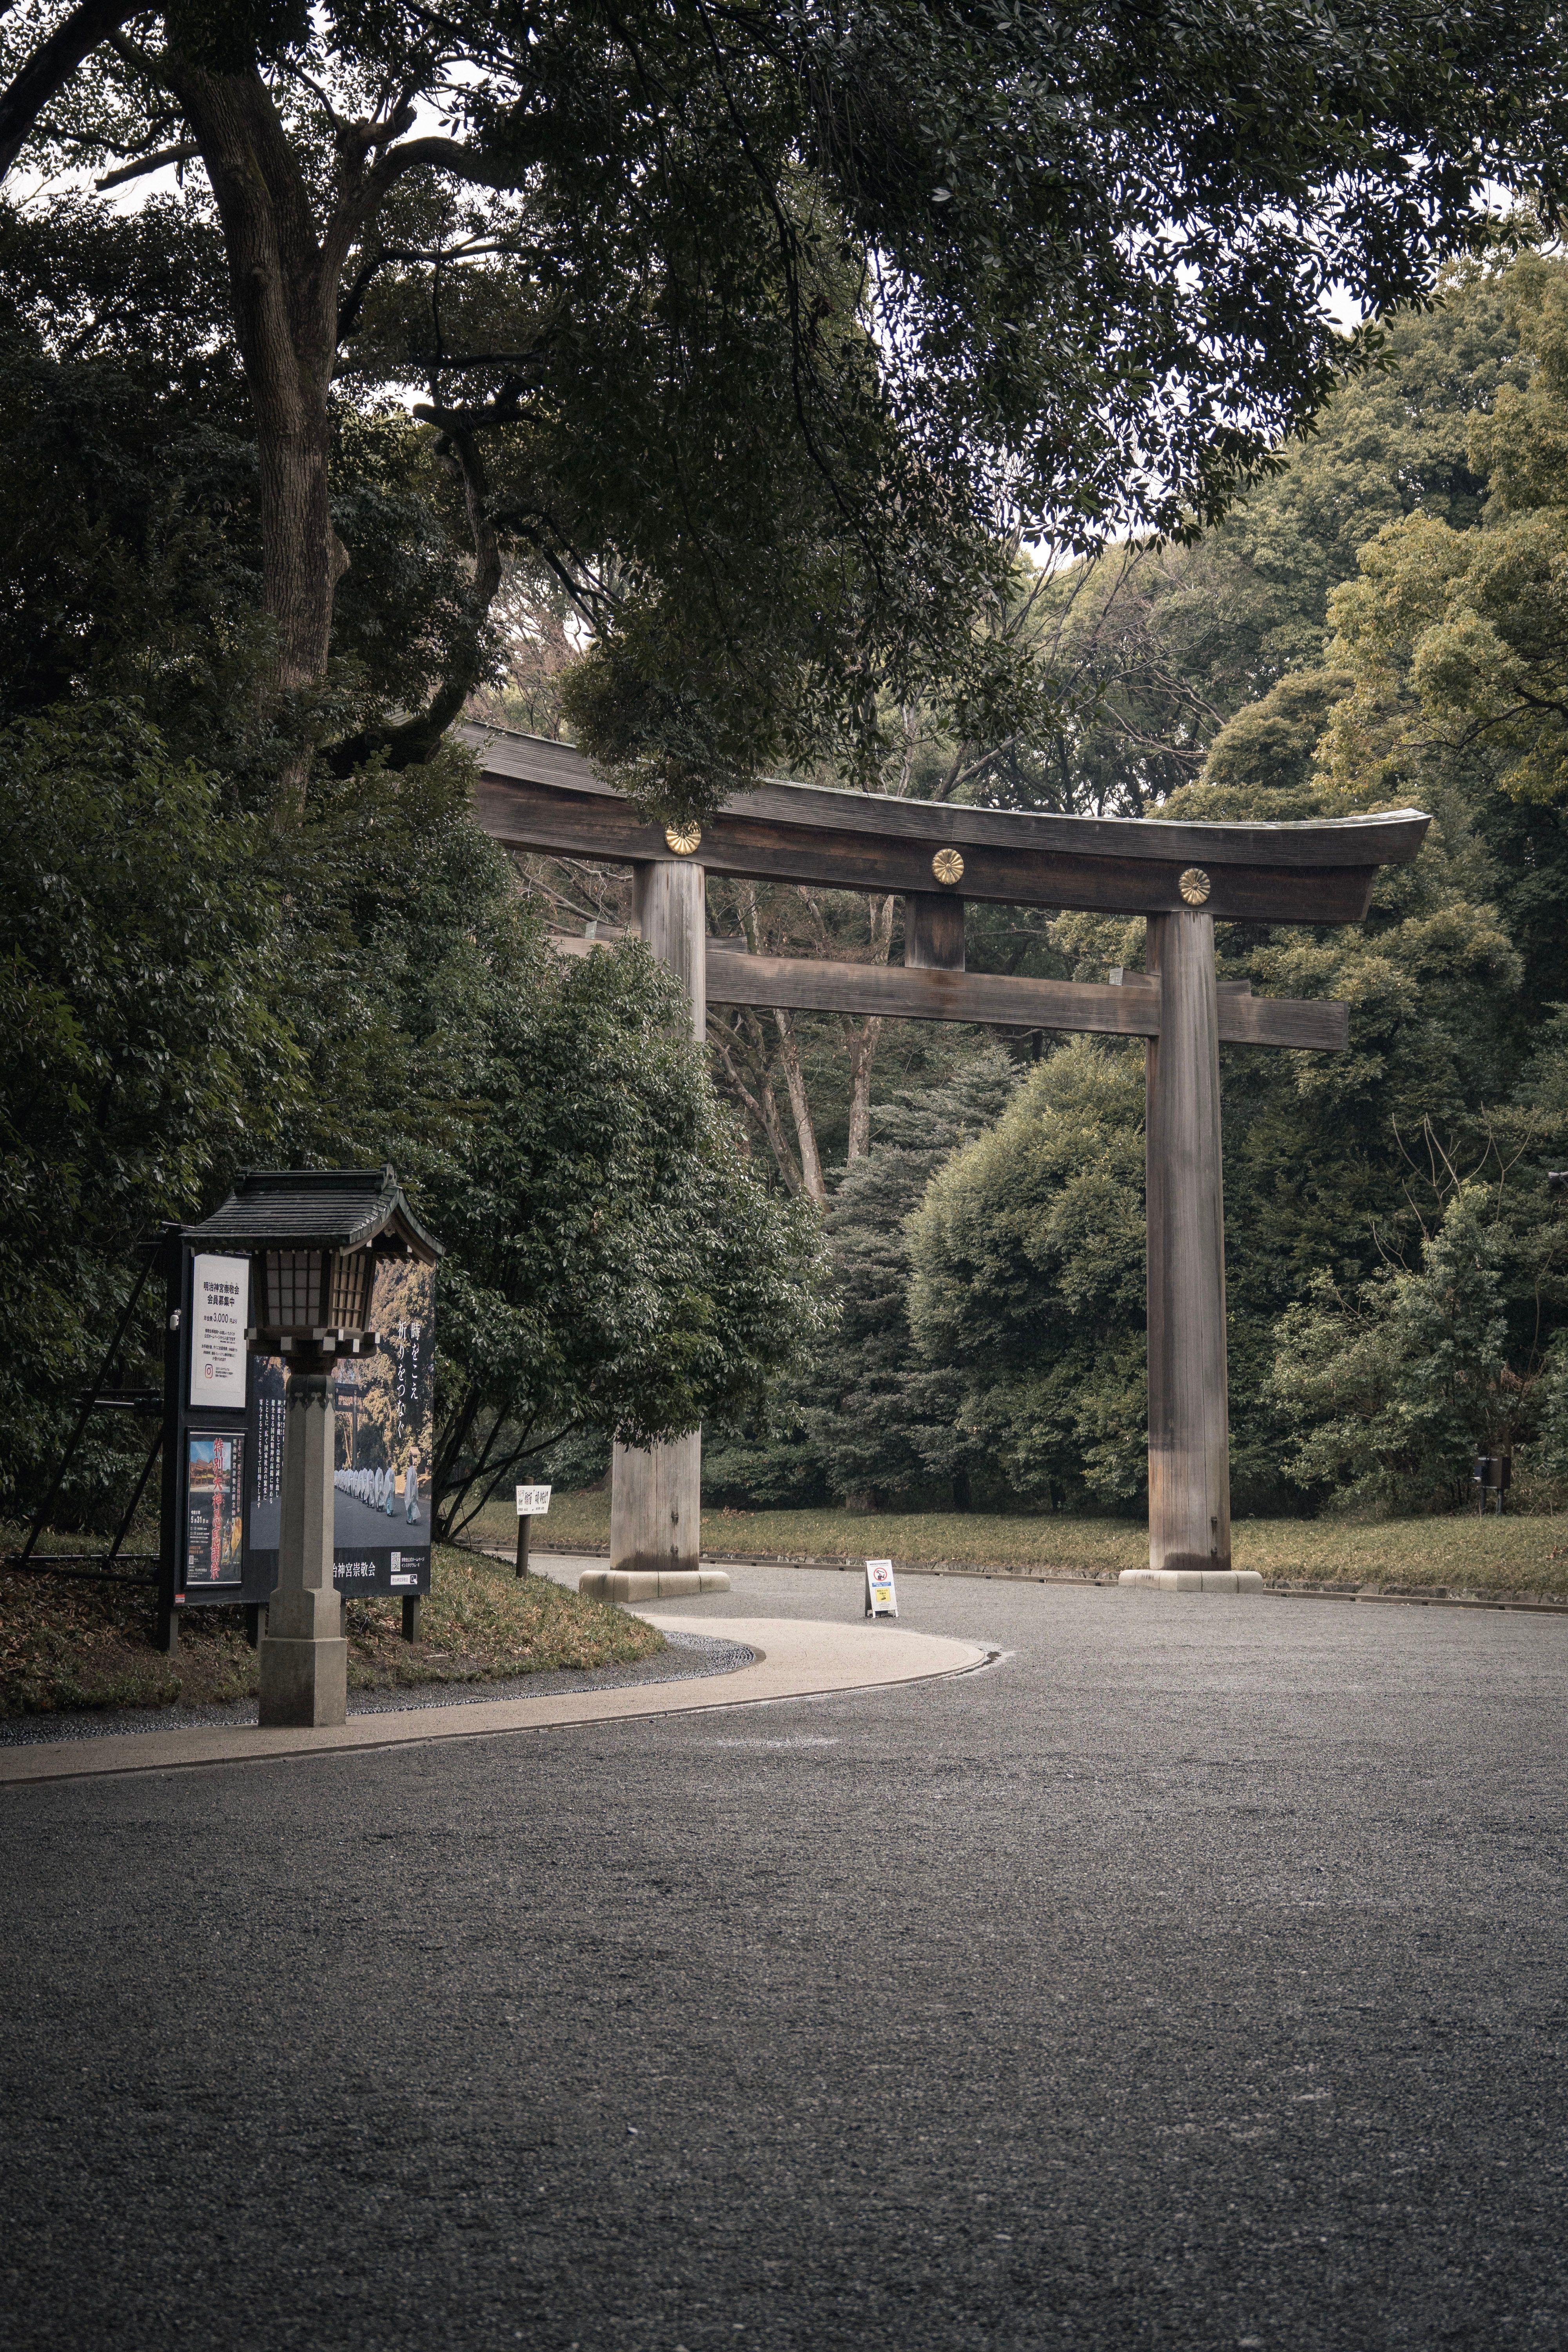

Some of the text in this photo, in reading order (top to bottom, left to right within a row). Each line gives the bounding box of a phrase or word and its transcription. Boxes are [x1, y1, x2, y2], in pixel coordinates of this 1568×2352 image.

[203, 1281, 239, 1295] 明治神宮崇敬会
[207, 1294, 235, 1307] 会員募集中
[213, 1312, 228, 1323] 3,000
[397, 1320, 407, 1438] 祈りをつなぐ
[411, 1322, 420, 1399] 時をこえ
[210, 1437, 223, 1580] 特別大神恩感謝祭
